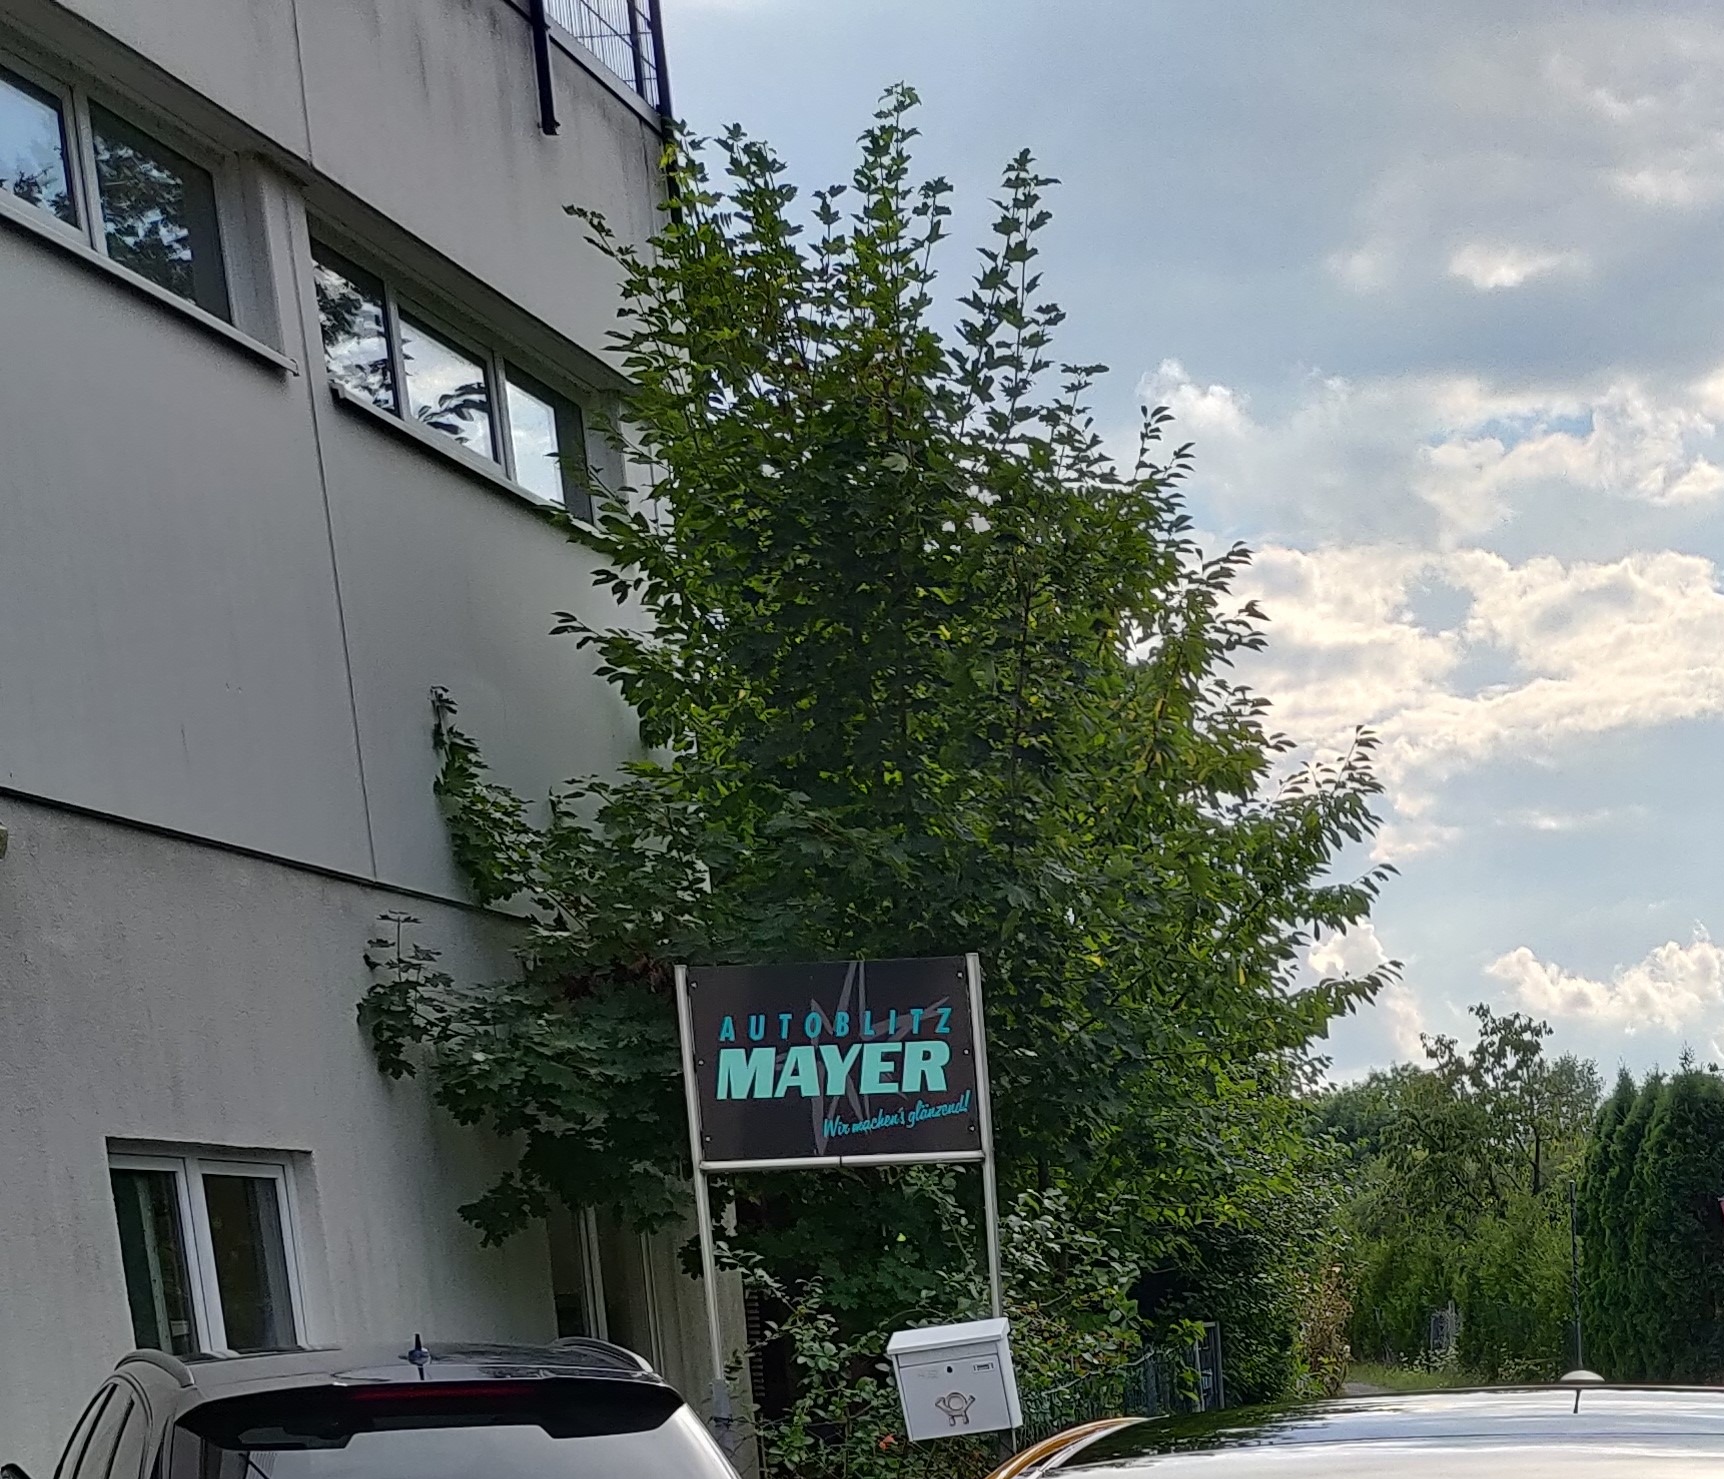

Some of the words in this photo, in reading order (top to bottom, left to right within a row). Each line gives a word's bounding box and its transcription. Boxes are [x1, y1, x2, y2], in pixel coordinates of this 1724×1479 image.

[719, 1007, 952, 1042] AUTOBLITZ
[716, 1040, 950, 1100] MAYER
[824, 1115, 850, 1137] Wir
[906, 1089, 971, 1128] glänzend!
